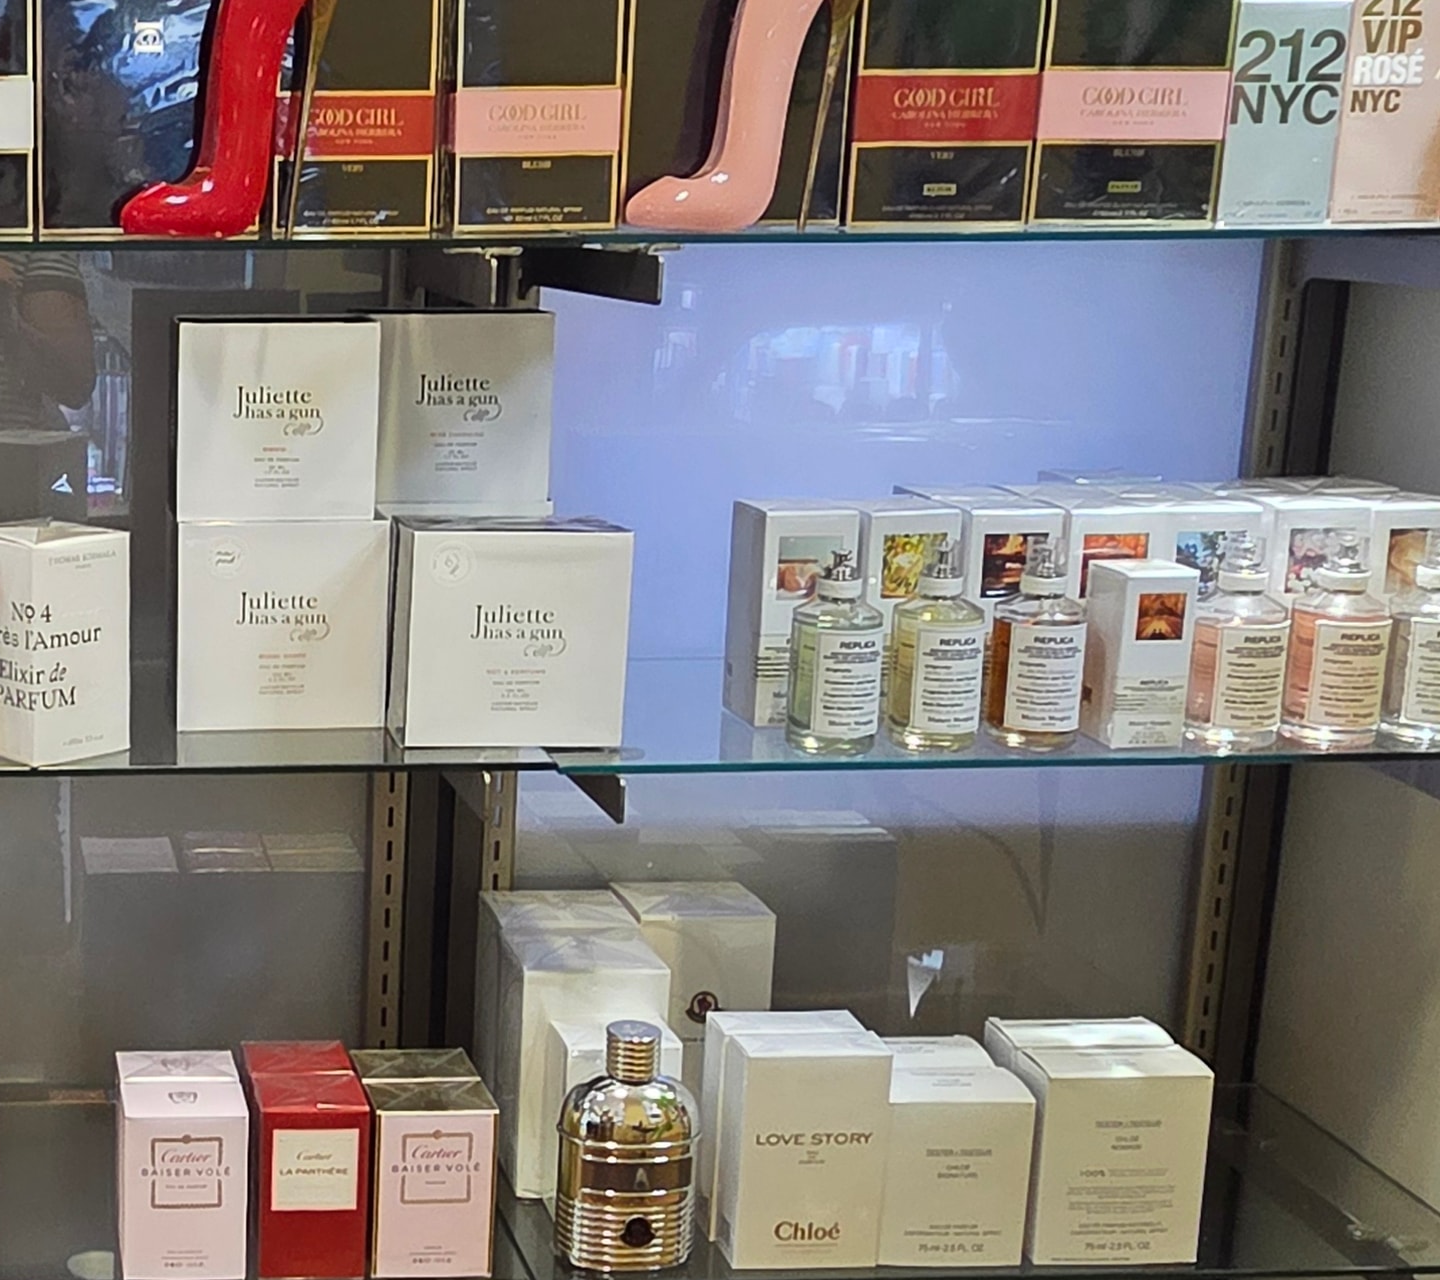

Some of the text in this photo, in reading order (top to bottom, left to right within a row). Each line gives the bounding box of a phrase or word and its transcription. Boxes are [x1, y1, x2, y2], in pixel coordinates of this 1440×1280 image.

[1362, 19, 1423, 54] VIP
[1233, 27, 1347, 84] 212
[1352, 48, 1425, 86] ROSÉ
[893, 87, 1000, 108] GOOD GIRL
[1082, 86, 1189, 106] GOOD GIRL
[1229, 83, 1341, 125] NYC
[1350, 88, 1401, 114] NYC
[356, 108, 405, 126] GIRL
[487, 103, 588, 121] GOOD GIRL
[355, 127, 402, 137] HERRERA
[415, 374, 491, 406] Juliette
[232, 385, 313, 419] Juliette
[427, 391, 499, 408] has a gun
[245, 405, 321, 421] has a gun
[40, 604, 53, 623] 4
[236, 591, 319, 625] Juliette
[248, 610, 328, 627] has a gun
[471, 604, 555, 639] Juliette
[24, 626, 102, 651] l'Amour
[483, 625, 564, 642] has a gun
[939, 637, 977, 647] REPLICA
[1033, 636, 1075, 645] REPLICA
[1243, 635, 1282, 644] REPLICA
[1340, 633, 1381, 642] REPLICA
[839, 640, 876, 650] REPLICA
[48, 662, 68, 683] de
[755, 1131, 873, 1146] LOVE STORY
[160, 1143, 212, 1164] Cartier
[295, 1149, 333, 1162] Cartier
[411, 1138, 463, 1160] Cartier
[141, 1165, 232, 1177] BAISER VOLÉ
[279, 1168, 293, 1177] LA
[391, 1161, 481, 1174] BAISER VOLÉ
[773, 1219, 842, 1242] Chloé
